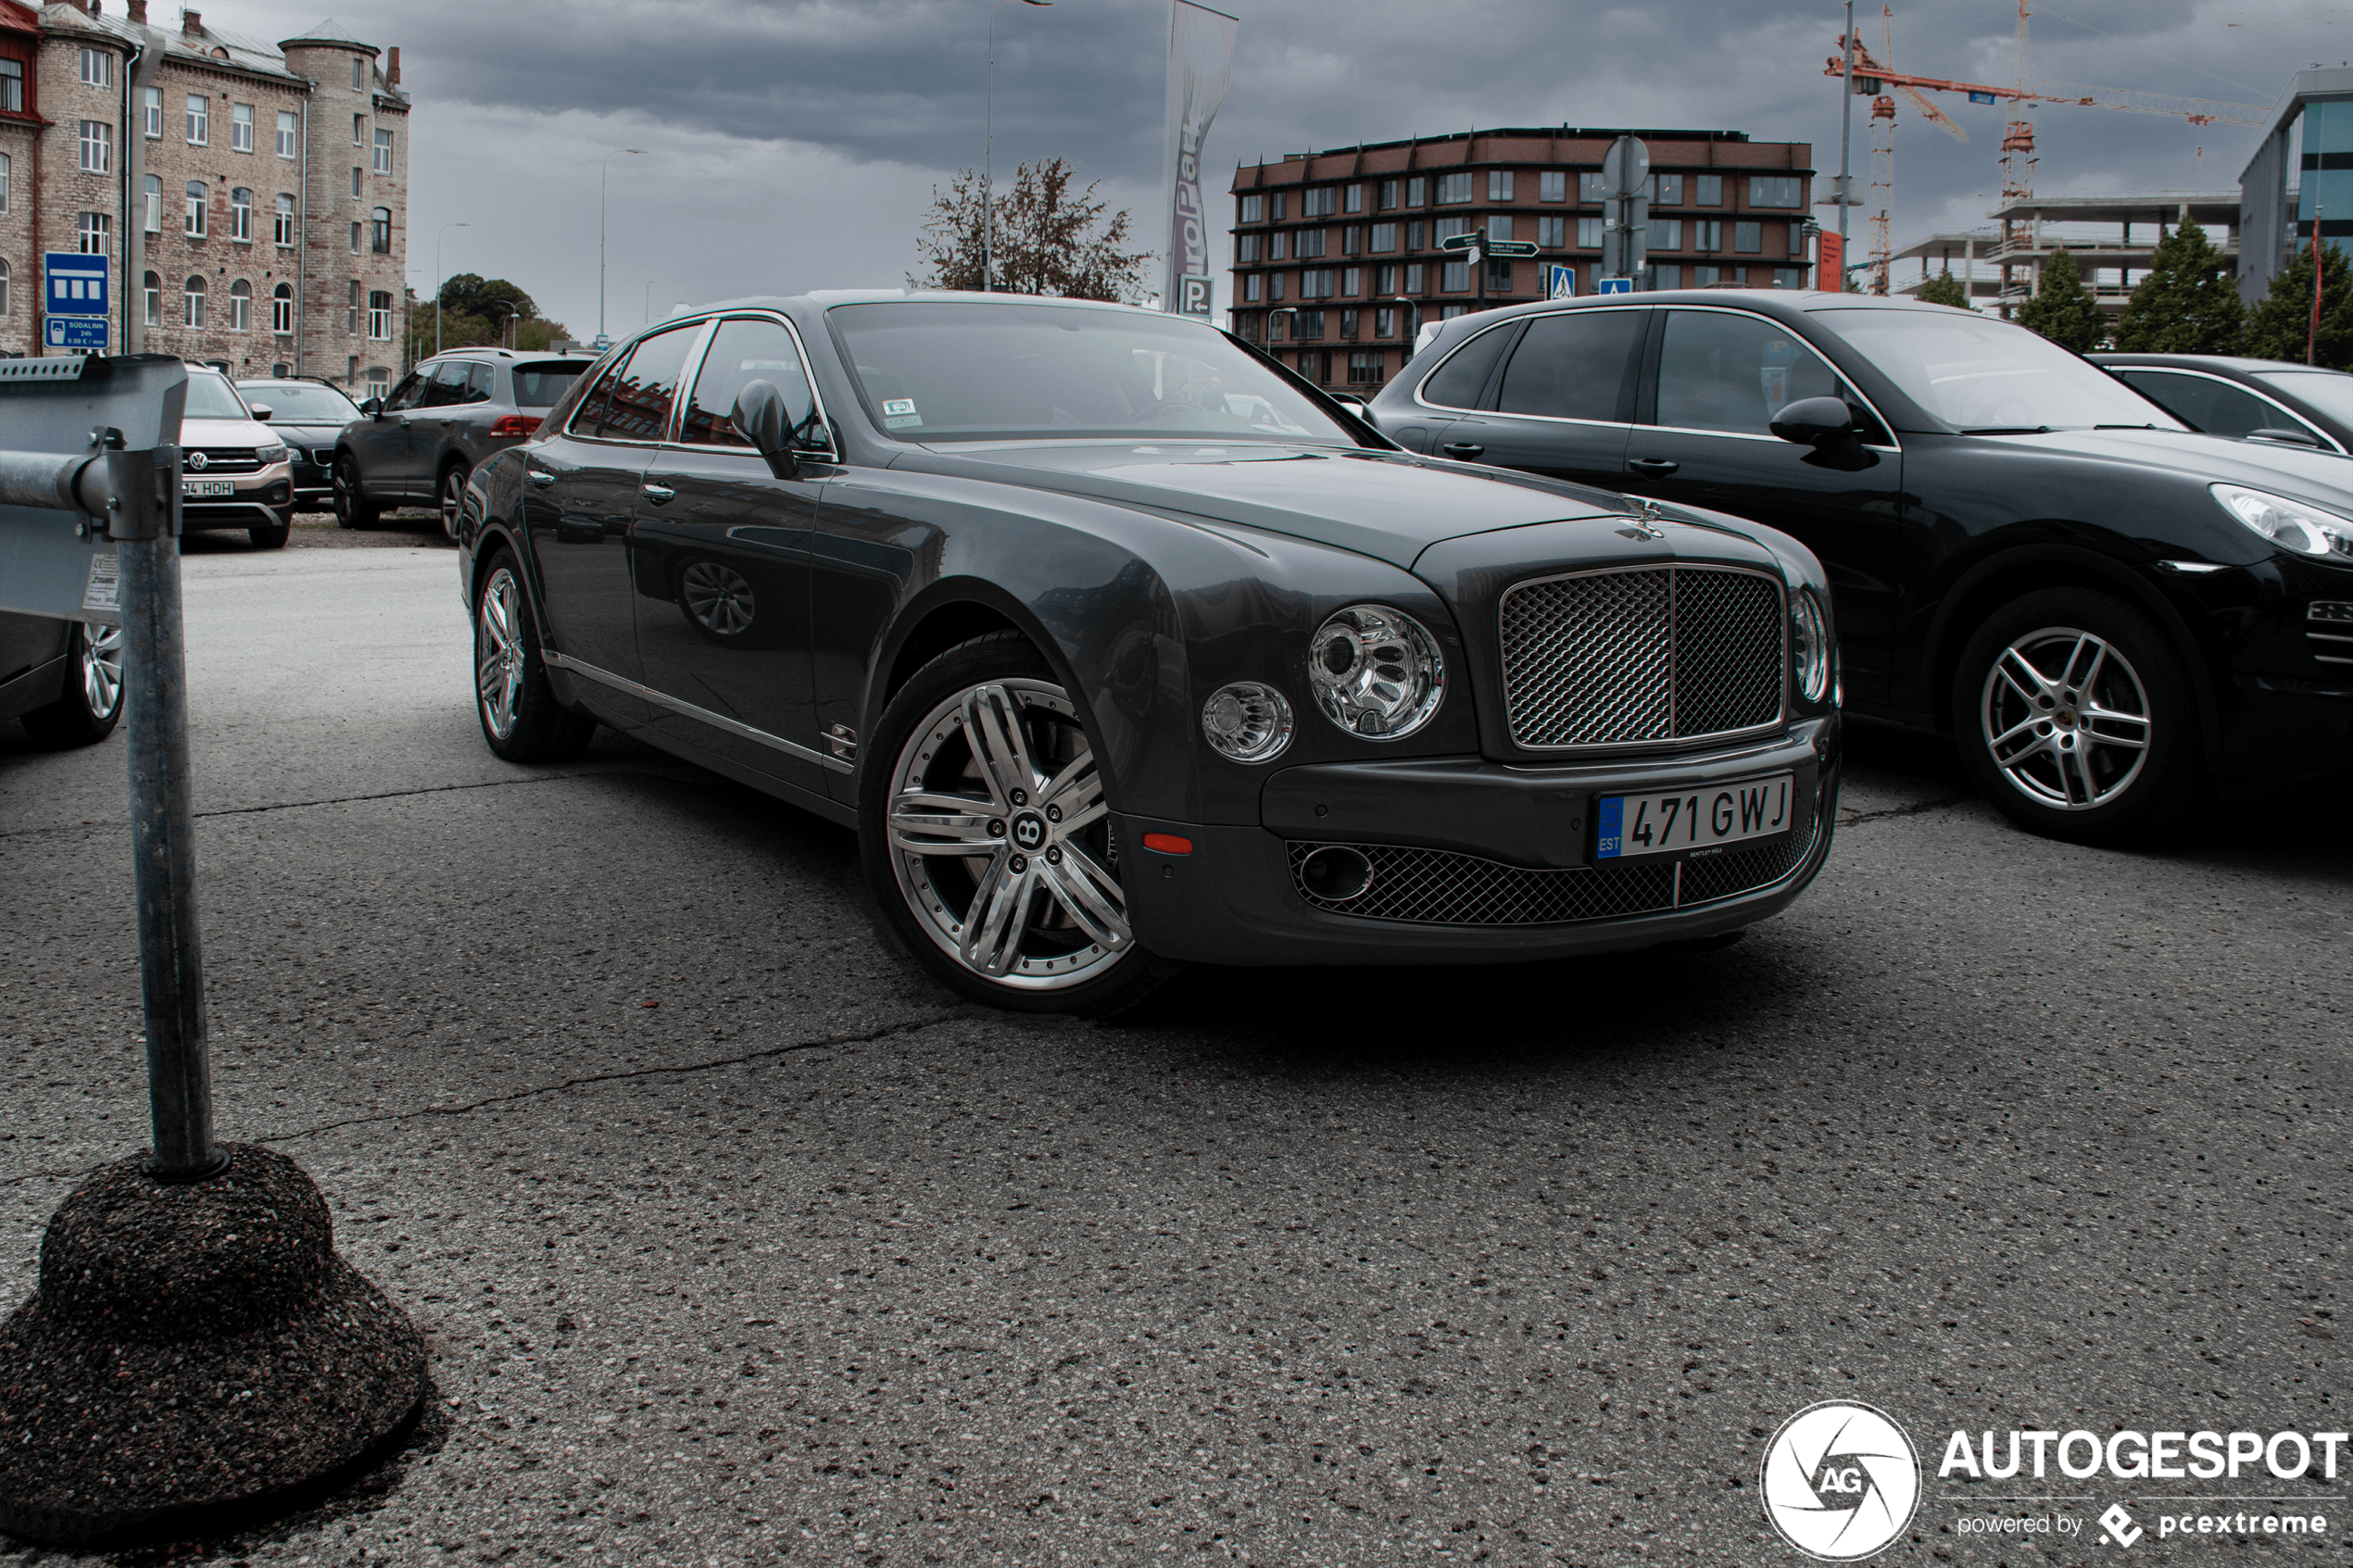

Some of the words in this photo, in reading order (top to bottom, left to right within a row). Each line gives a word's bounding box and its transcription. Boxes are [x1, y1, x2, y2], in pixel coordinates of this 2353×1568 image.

[1176, 113, 1205, 274] roPark
[1187, 282, 1204, 312] P
[203, 483, 231, 494] HDH
[1631, 795, 1698, 847] 471
[1711, 781, 1787, 837] GWJ
[1017, 820, 1040, 845] B
[1599, 836, 1621, 852] EST
[1689, 849, 1712, 859] BENTLEY
